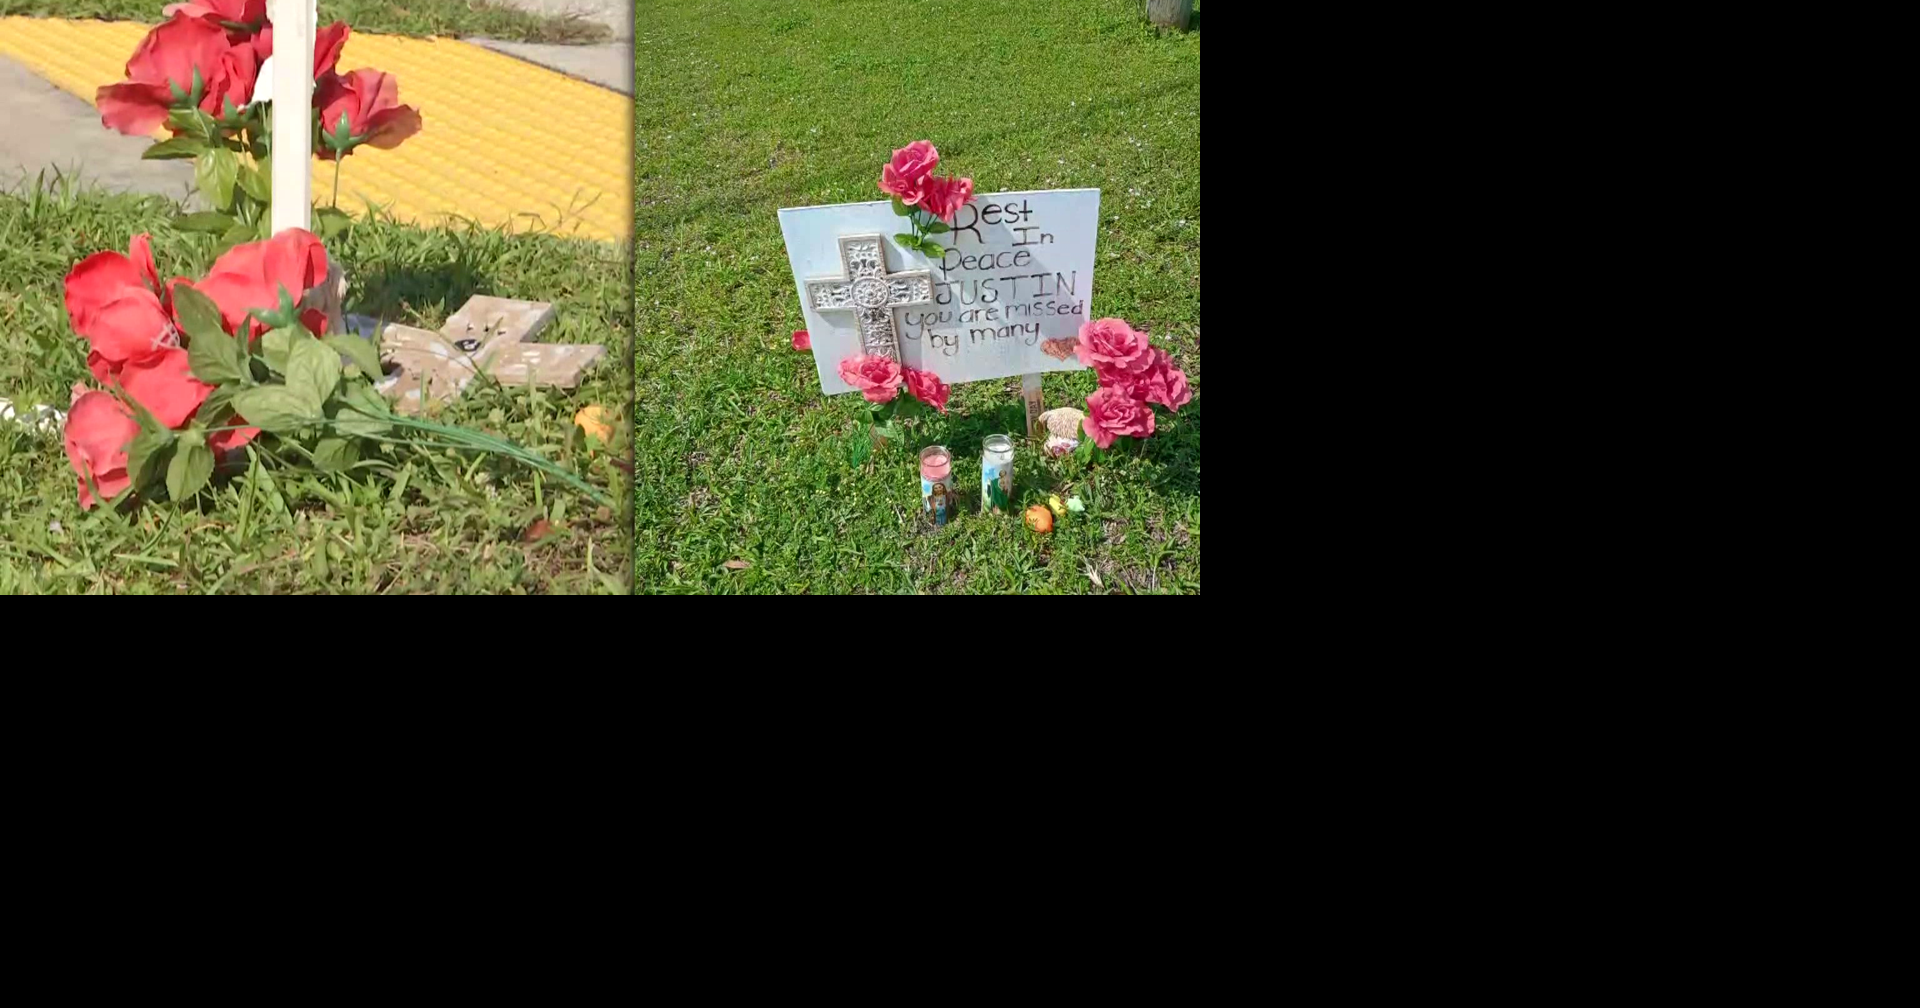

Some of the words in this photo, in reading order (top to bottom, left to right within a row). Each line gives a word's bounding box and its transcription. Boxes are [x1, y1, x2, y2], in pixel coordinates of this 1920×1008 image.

[950, 199, 1033, 245] Rest
[1012, 226, 1054, 246] In
[935, 271, 1077, 305] JUSTIN
[905, 310, 954, 340] you
[959, 307, 999, 323] are
[1005, 300, 1084, 319] missed
[927, 329, 959, 356] by
[970, 322, 1040, 345] many
